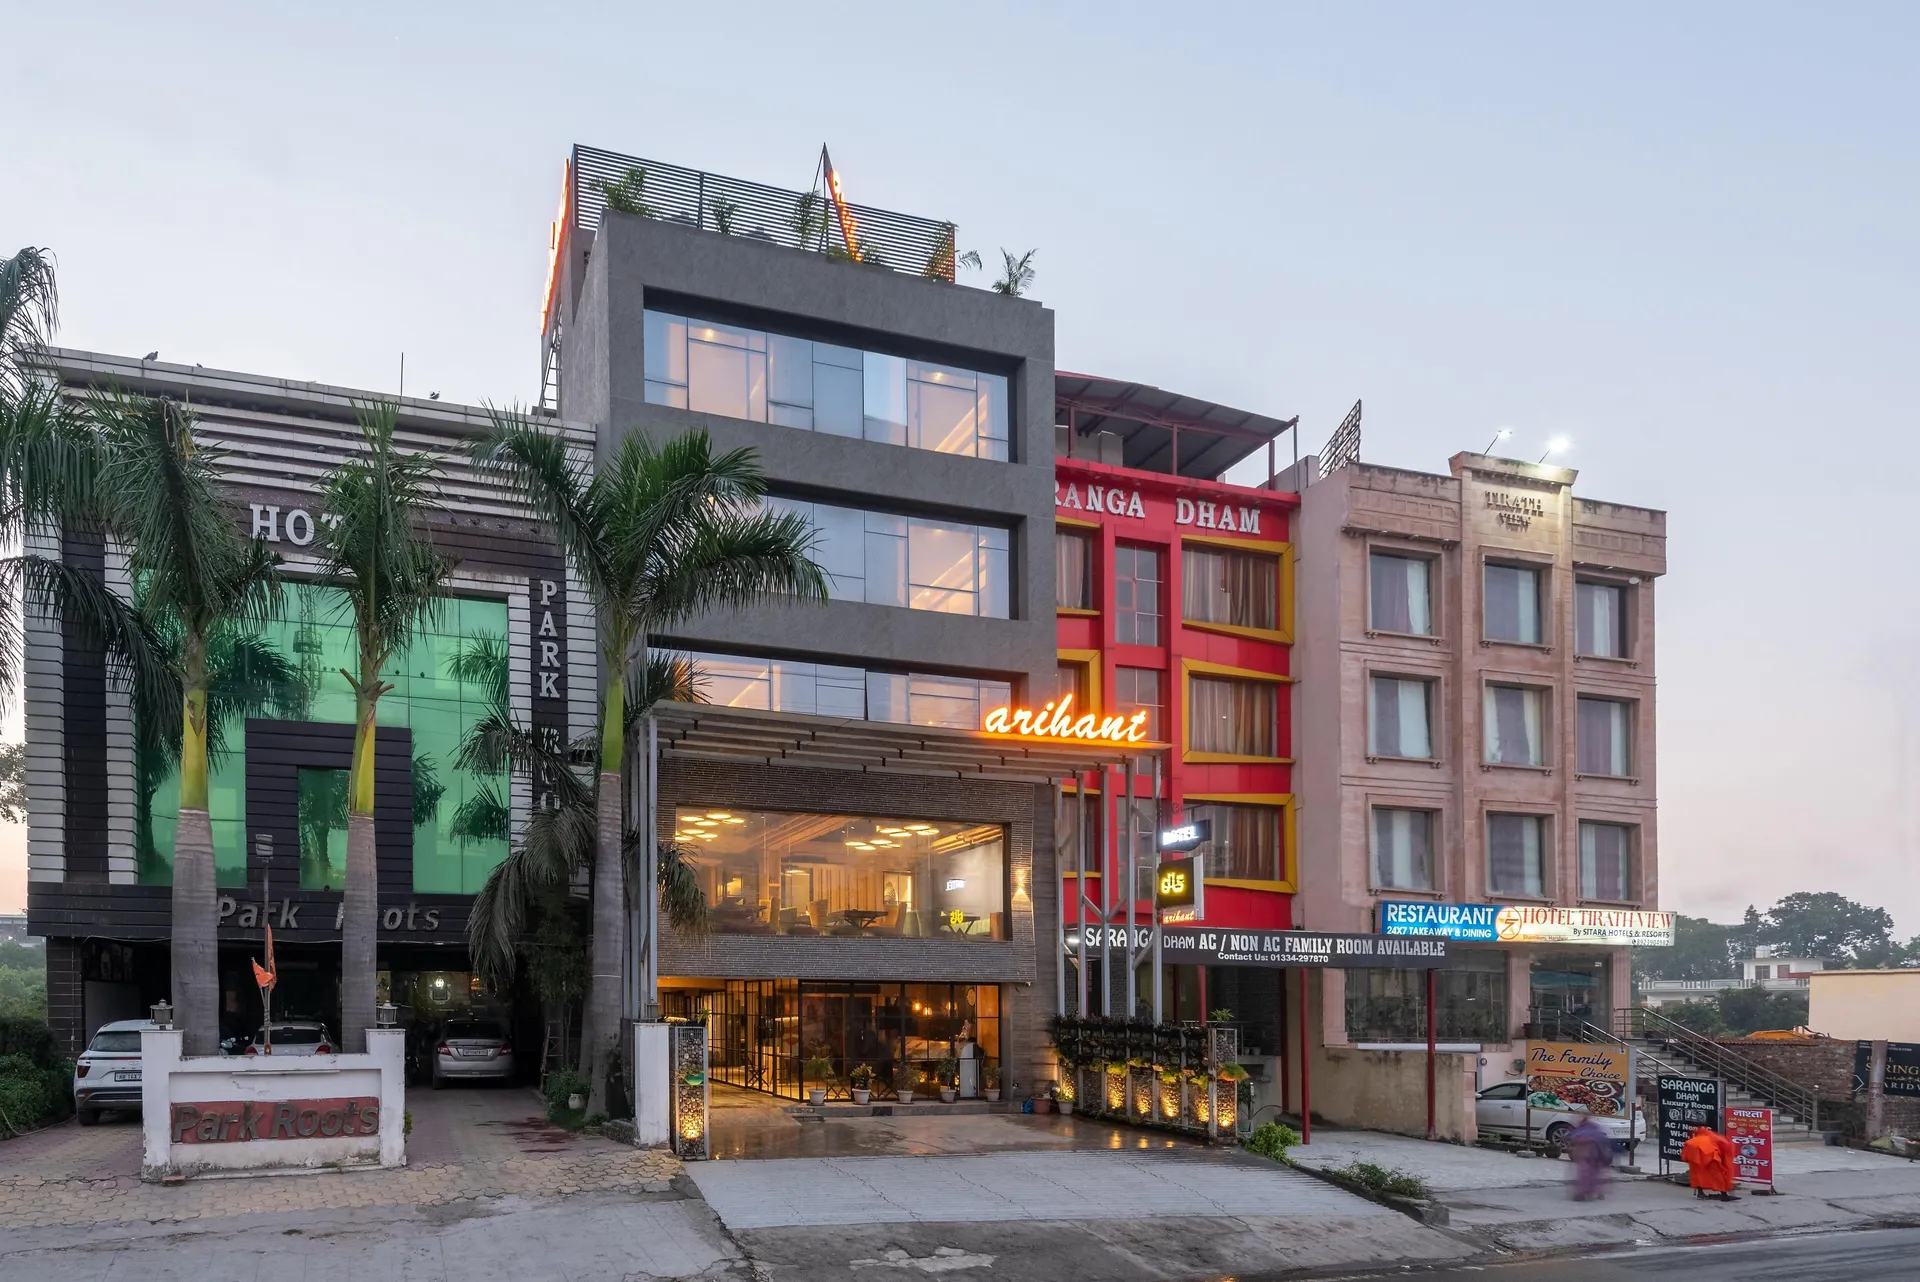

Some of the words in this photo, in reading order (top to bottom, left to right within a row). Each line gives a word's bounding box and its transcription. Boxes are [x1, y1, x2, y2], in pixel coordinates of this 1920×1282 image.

[1176, 498, 1260, 534] DHAM
[539, 579, 560, 698] PARK
[985, 694, 1147, 742] arihant
[1163, 910, 1195, 923] arihant
[1387, 904, 1494, 925] RESTAURANT
[1523, 907, 1575, 925] HOTEL
[1580, 910, 1633, 928] TIRATH
[1636, 912, 1673, 929] VIEW
[1386, 926, 1407, 936] 24X7
[1409, 927, 1454, 937] TAKEAWAY
[1462, 929, 1492, 938] DINING
[1573, 928, 1582, 936] By
[1609, 930, 1634, 938] HOTELS
[1634, 930, 1641, 938] &
[1642, 931, 1670, 939] RESORTS
[1164, 935, 1194, 949] DHAM
[1199, 933, 1216, 950] AC
[1231, 935, 1259, 952] NON
[1263, 937, 1280, 952] AC
[1285, 937, 1332, 954] FAMILY
[1336, 938, 1373, 955] ROOM
[1377, 941, 1445, 957] AVAILABLE
[1218, 952, 1252, 961] Contact
[1256, 953, 1268, 961] Us:
[1270, 953, 1329, 963] 01334-297870
[1531, 1047, 1556, 1061] The
[1559, 1049, 1613, 1070] Family
[1580, 1066, 1621, 1080] Choice
[1661, 1079, 1715, 1094] SARANGA
[1662, 1099, 1689, 1108] Luxury
[1676, 1092, 1699, 1101] DHAM
[172, 1103, 264, 1142] Park
[270, 1102, 379, 1139] Roots
